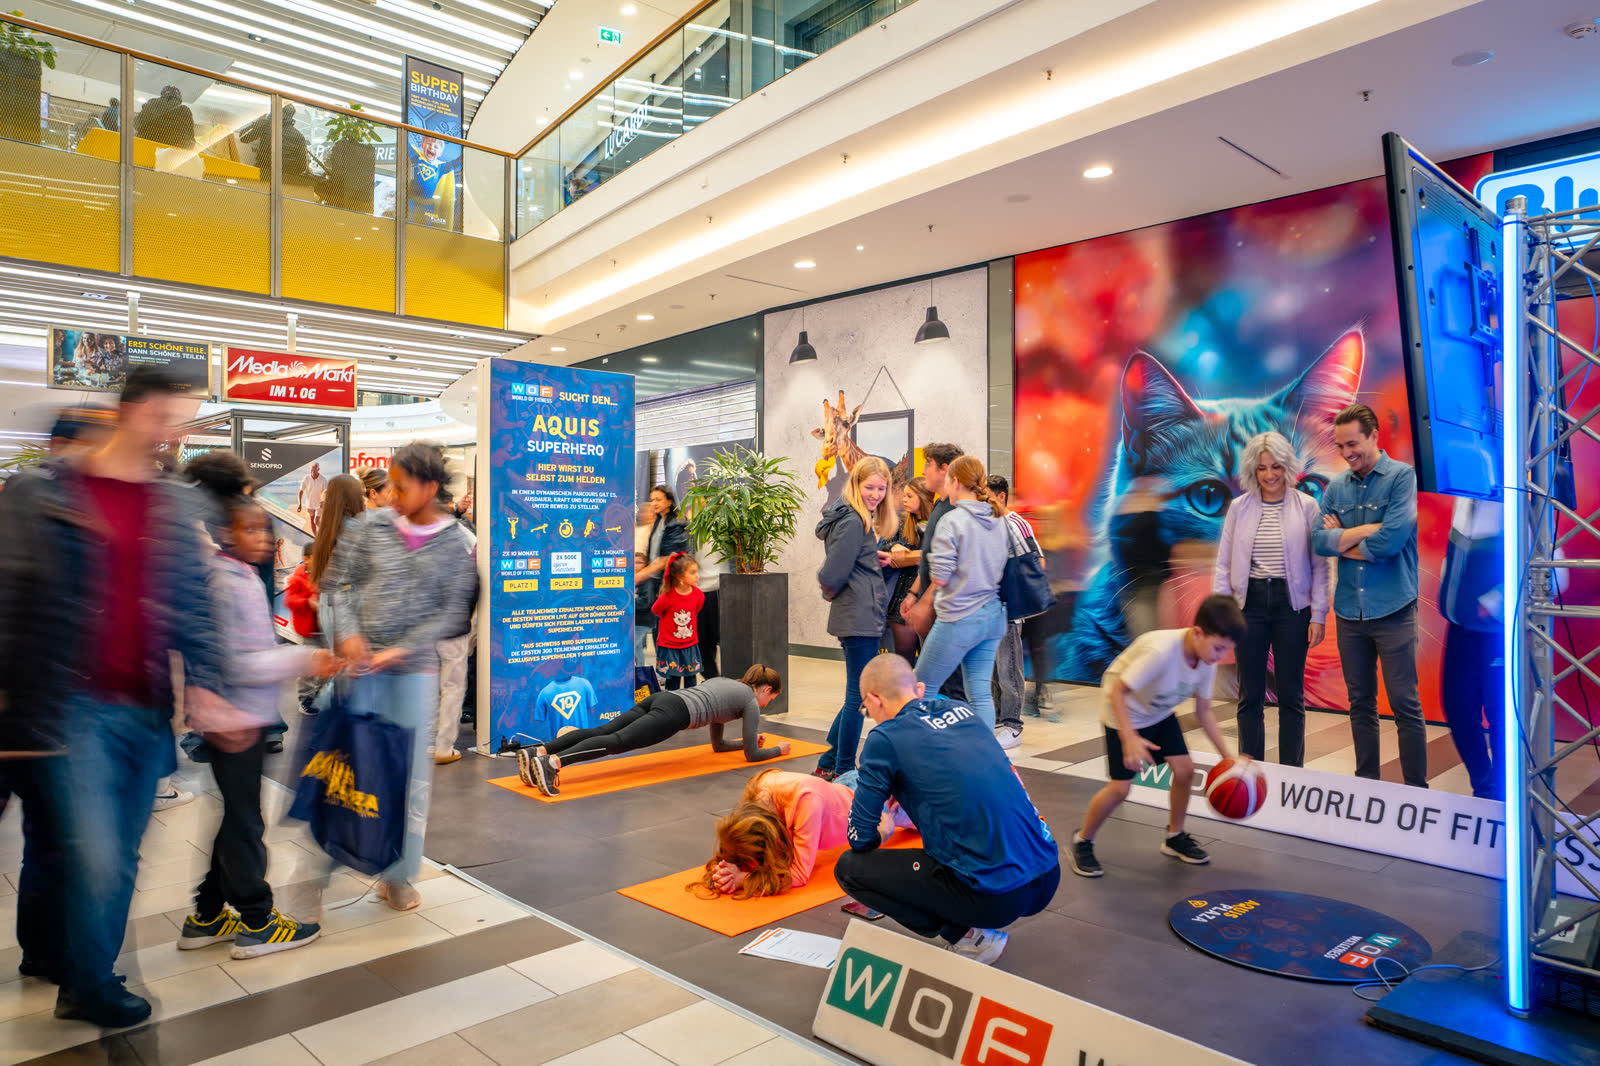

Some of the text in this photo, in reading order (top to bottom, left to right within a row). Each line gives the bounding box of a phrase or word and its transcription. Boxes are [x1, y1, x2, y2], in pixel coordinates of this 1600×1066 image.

[411, 71, 459, 95] SUPER
[410, 83, 459, 103] BIRTHDAY
[128, 340, 206, 354] ERST SCHÖNE TEILE.
[149, 349, 180, 358] SCHÖNES
[182, 353, 206, 361] TEILEN.
[228, 355, 354, 383] Media Markt
[269, 385, 286, 397] IM
[289, 387, 297, 399] 1.
[512, 384, 552, 396] WOF
[559, 391, 618, 406] SUCHT DEN...
[532, 414, 600, 440] AQUIS
[527, 439, 604, 456] SUPERHERO
[250, 462, 283, 470] SENSOPRO
[537, 463, 594, 474] HIER WIRST DU
[526, 473, 605, 484] SELBST ZUM HELDEN
[501, 559, 540, 569] WOF
[592, 557, 627, 568] WOF
[508, 656, 540, 664] EXKLUSIVES
[600, 711, 621, 720] AQUIS
[920, 706, 975, 730] Team
[1280, 781, 1385, 825] WORLD
[1397, 803, 1441, 834] OF
[1191, 903, 1234, 923] PLAZA
[1223, 899, 1261, 919] AQUIS
[1345, 935, 1398, 966] WOF
[840, 954, 1034, 1066] WOF
